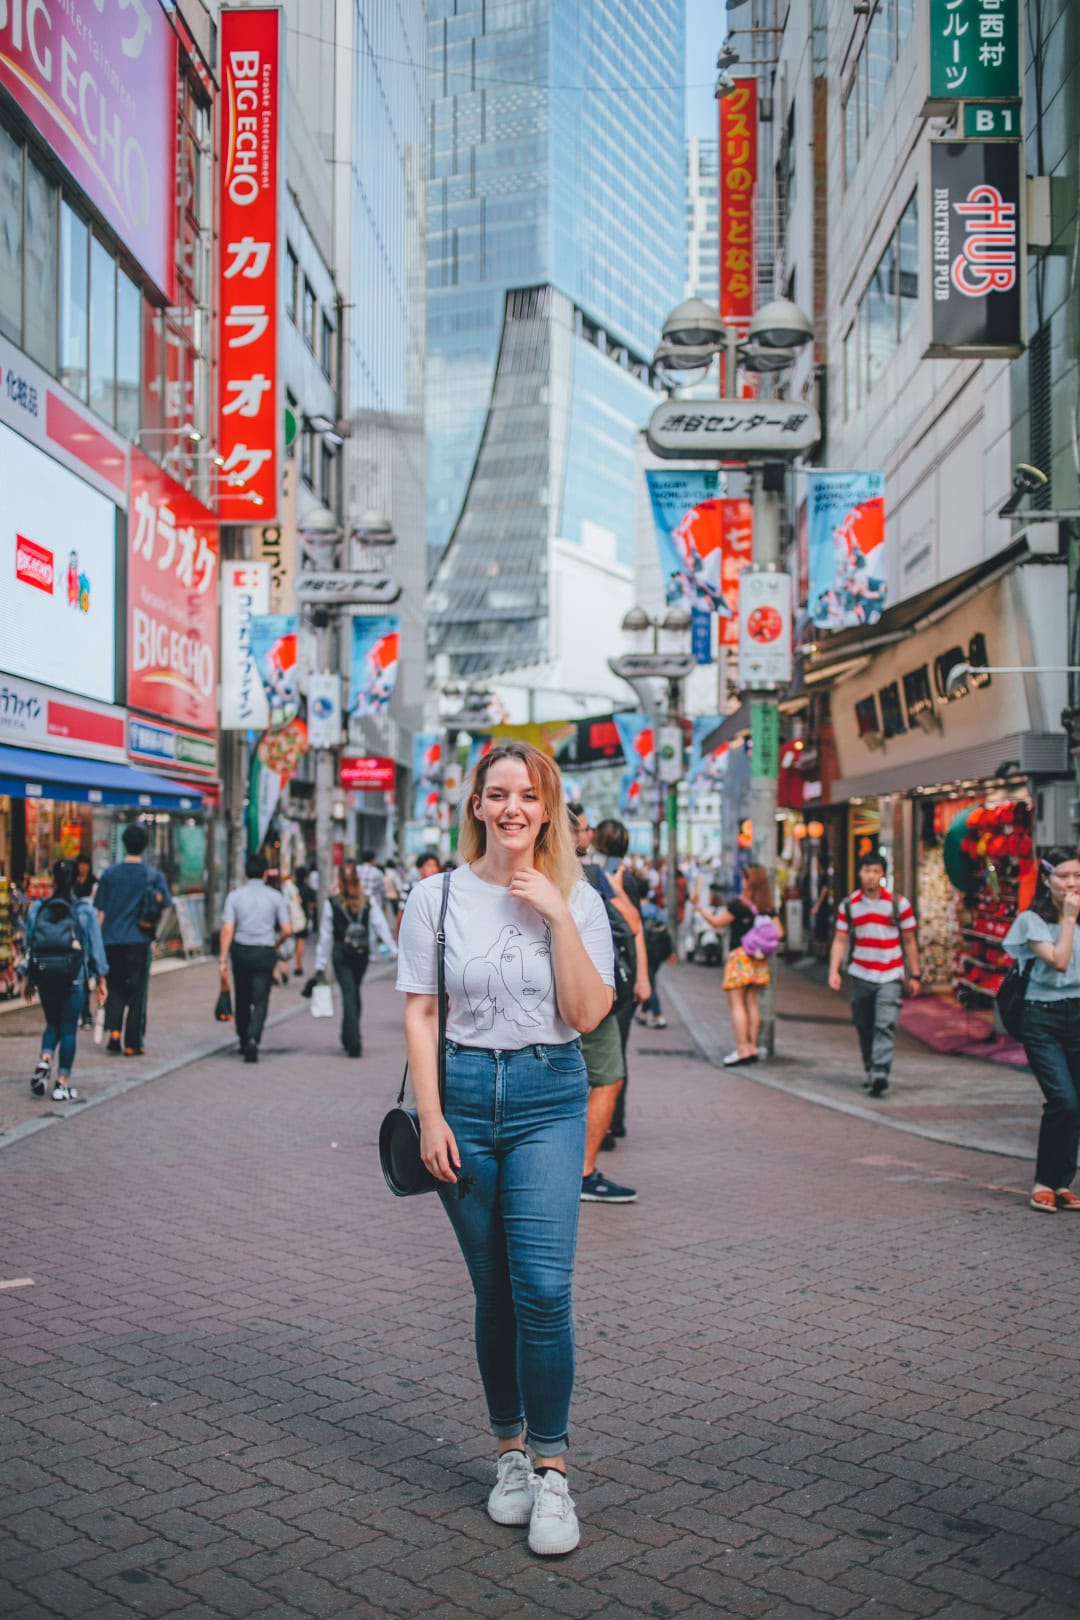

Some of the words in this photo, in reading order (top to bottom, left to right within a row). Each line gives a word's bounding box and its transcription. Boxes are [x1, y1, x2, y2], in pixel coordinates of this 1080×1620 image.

[229, 51, 260, 111] BIG
[262, 63, 272, 107] Karaoke
[61, 34, 150, 230] ECHO
[229, 116, 259, 206] ECHO
[725, 87, 752, 298] クスリのことなら
[934, 188, 949, 260] BRITISH
[934, 264, 950, 301] PUB
[951, 184, 1016, 298] HUB
[222, 236, 272, 483] カラオケ
[660, 413, 809, 433] 渋谷センター街
[132, 606, 169, 672] BIG
[170, 631, 214, 697] ECHO
